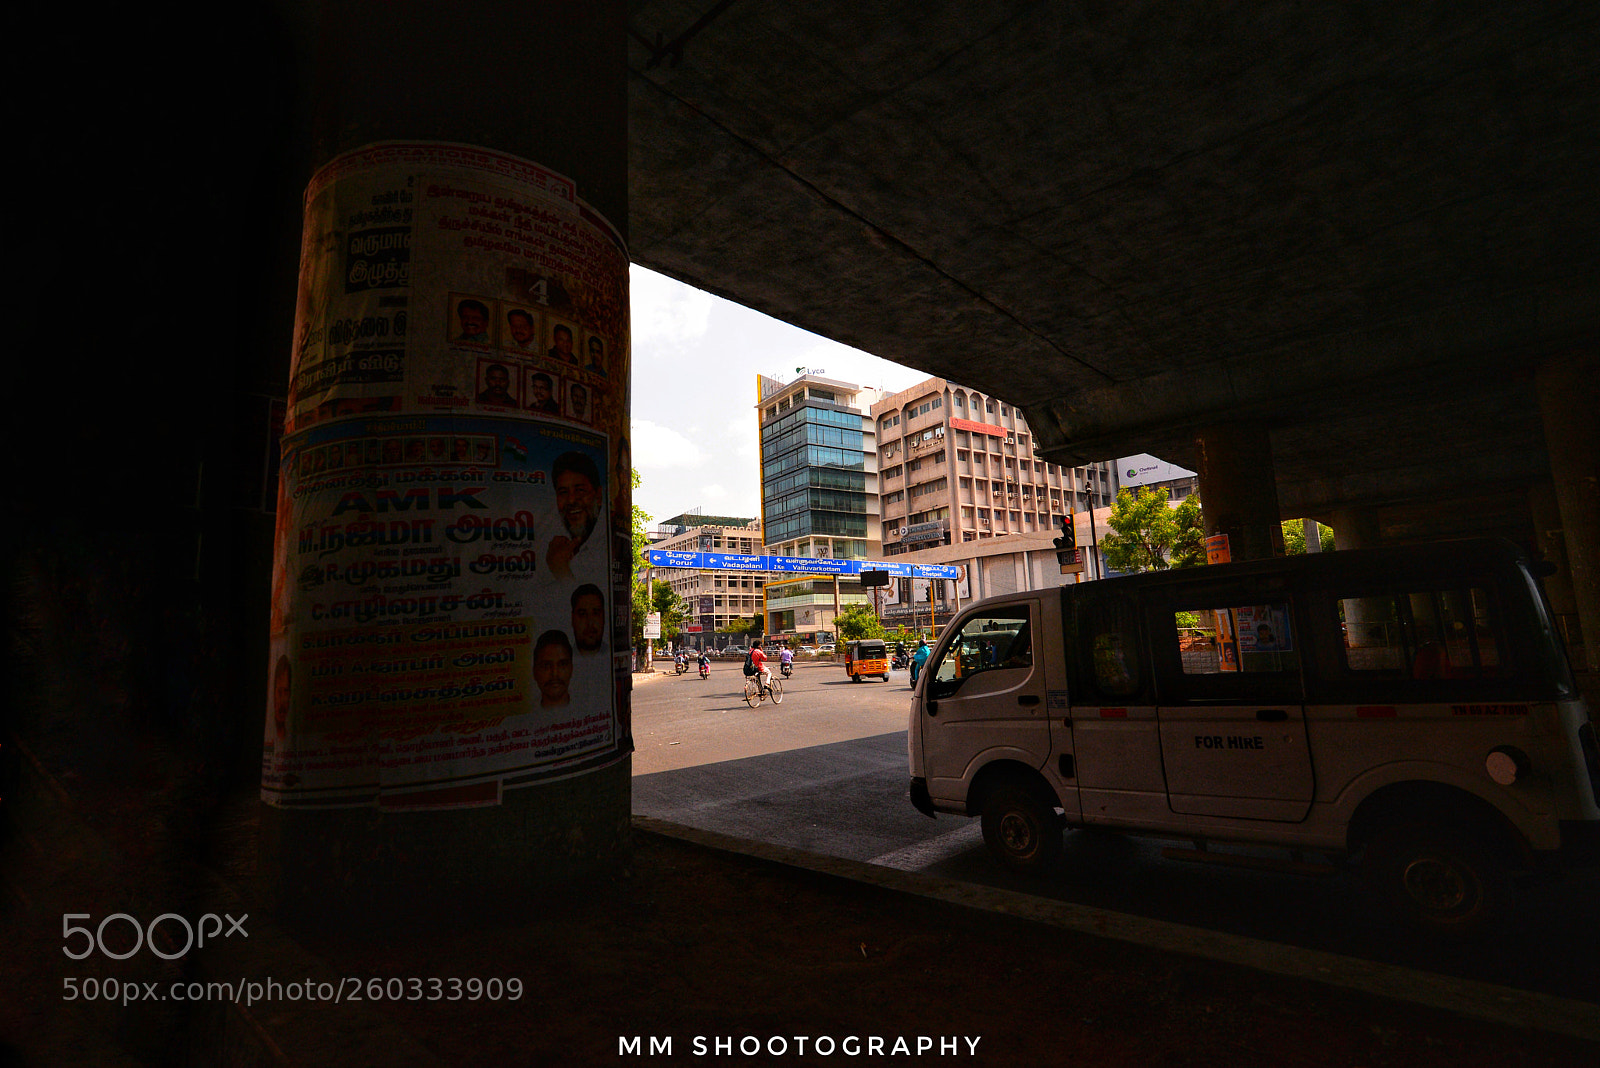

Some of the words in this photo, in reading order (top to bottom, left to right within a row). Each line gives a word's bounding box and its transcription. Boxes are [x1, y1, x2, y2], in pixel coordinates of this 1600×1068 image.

[528, 279, 550, 306] 4
[807, 367, 825, 376] Lyca
[293, 470, 390, 500] அனைத்து
[396, 467, 486, 484] மக்கள்
[491, 470, 546, 486] கட்சி
[332, 487, 488, 517] AMK
[446, 510, 535, 544] அலி
[469, 551, 536, 576] அலி
[669, 559, 694, 567] Porur
[721, 561, 764, 570] Vadapalani
[792, 564, 841, 573] Valluvarkottam
[452, 647, 516, 668] அலி
[1195, 736, 1223, 750] FOR
[1227, 736, 1264, 750] HIRE
